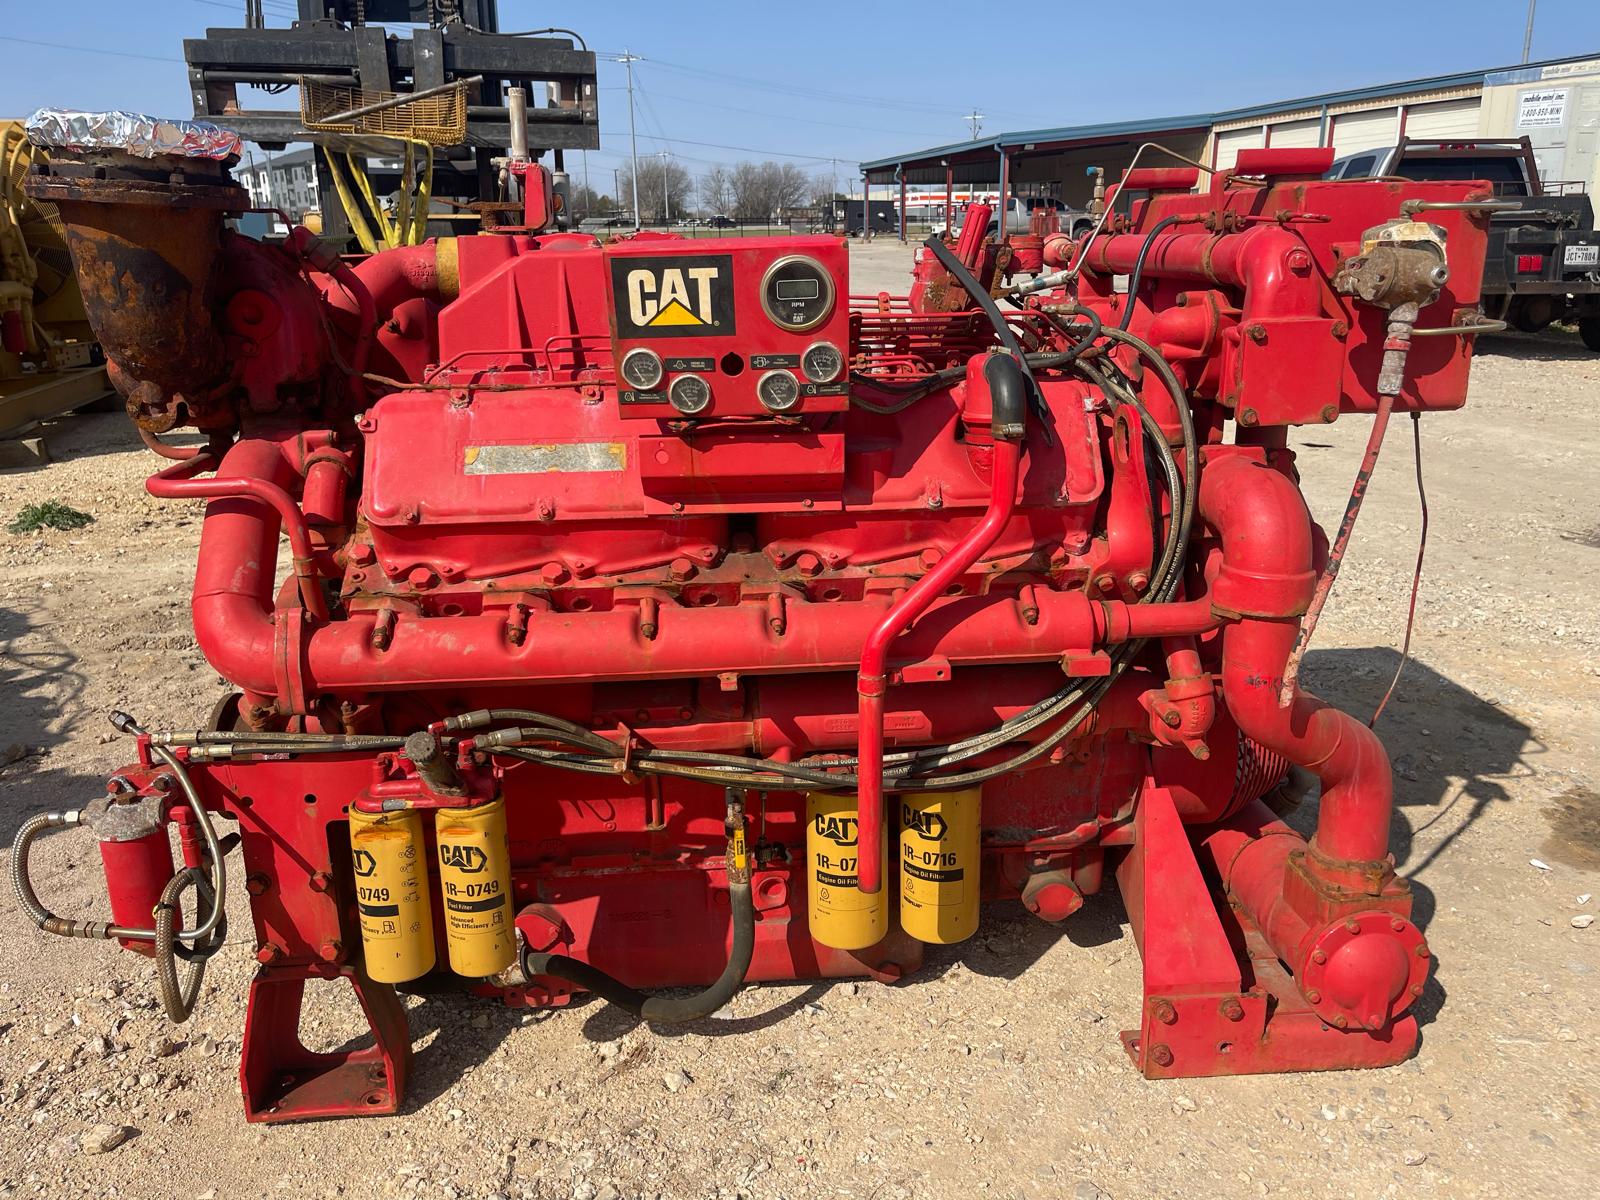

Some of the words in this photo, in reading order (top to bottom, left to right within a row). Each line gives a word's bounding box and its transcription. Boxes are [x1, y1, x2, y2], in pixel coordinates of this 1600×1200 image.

[627, 267, 719, 327] CAT
[792, 315, 804, 323] CAT
[815, 813, 850, 841] CAT
[903, 803, 935, 836] CAT
[440, 844, 475, 868] CAT
[816, 852, 858, 872] 1R-07
[904, 843, 957, 867] 1R-0716
[818, 873, 836, 885] Engine
[904, 862, 920, 876] Engine
[920, 870, 929, 878] Oil
[929, 872, 945, 880] Filter
[445, 880, 499, 897] 1R-0749
[450, 914, 474, 924] Advanced
[450, 920, 461, 929] High
